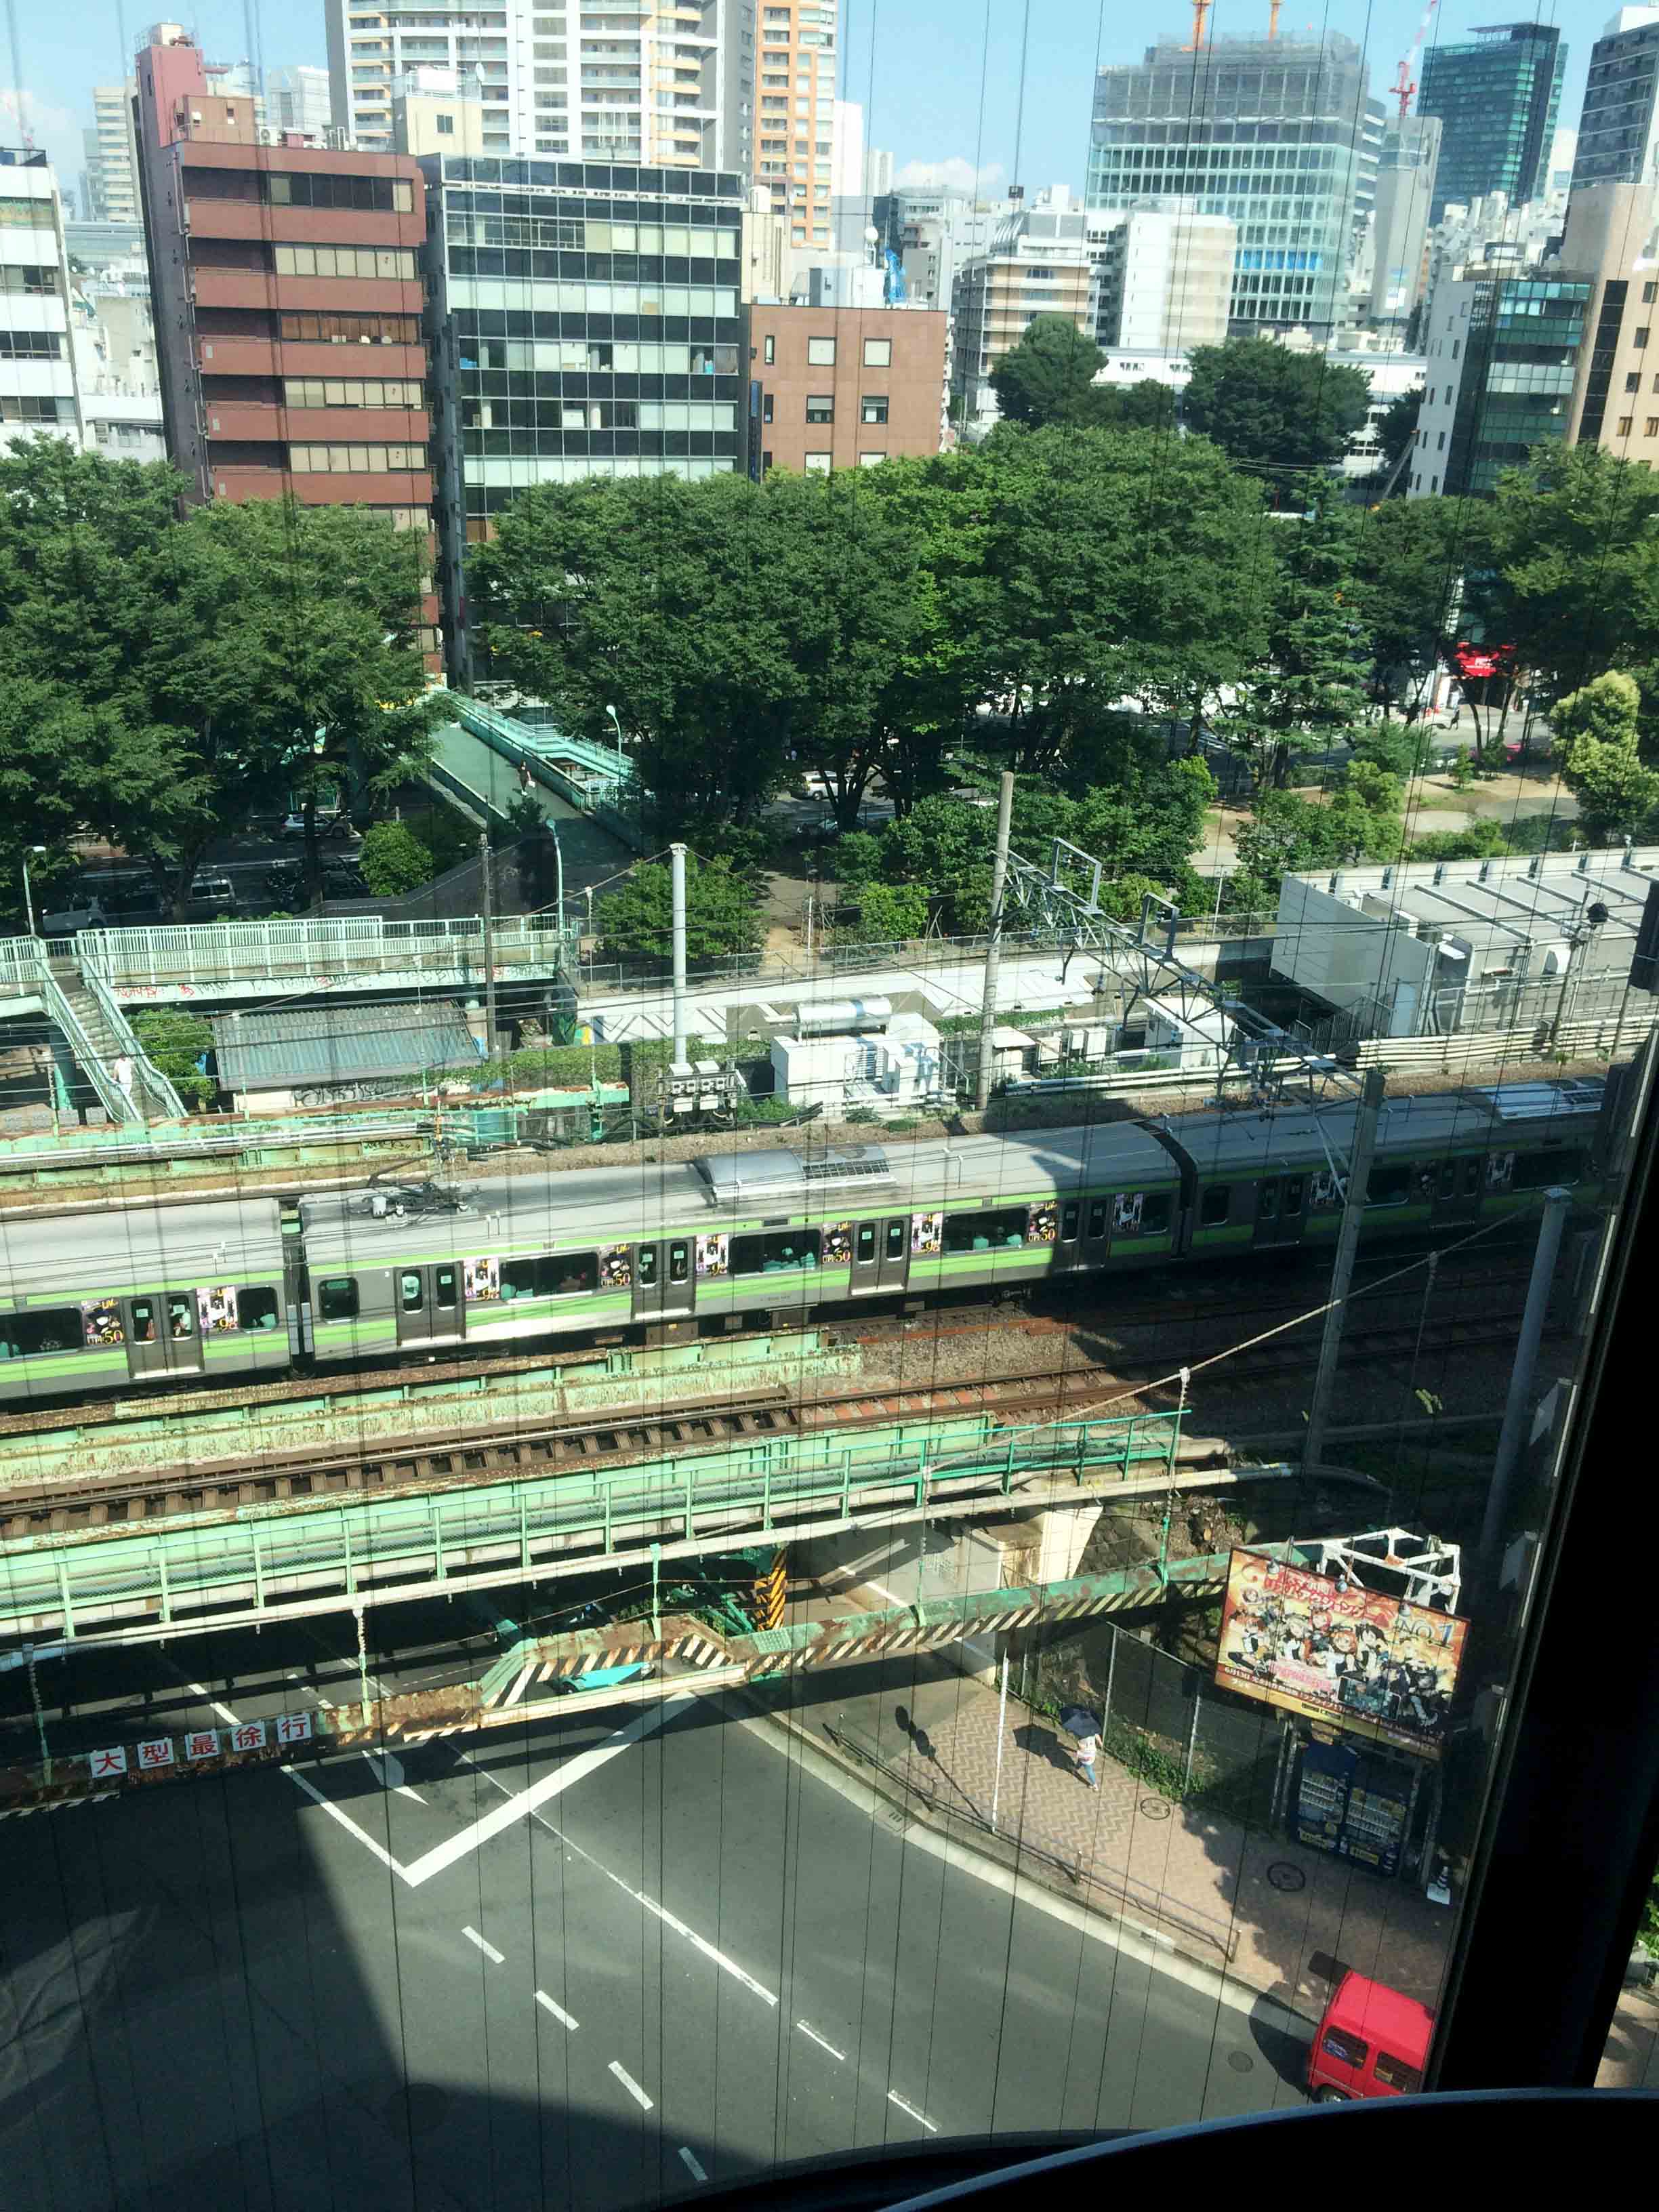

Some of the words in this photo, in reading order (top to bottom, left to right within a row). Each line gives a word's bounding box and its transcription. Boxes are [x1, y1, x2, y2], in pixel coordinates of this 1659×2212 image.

[104, 1330, 123, 1345] 50
[95, 1716, 308, 1775] 大型最徐行
